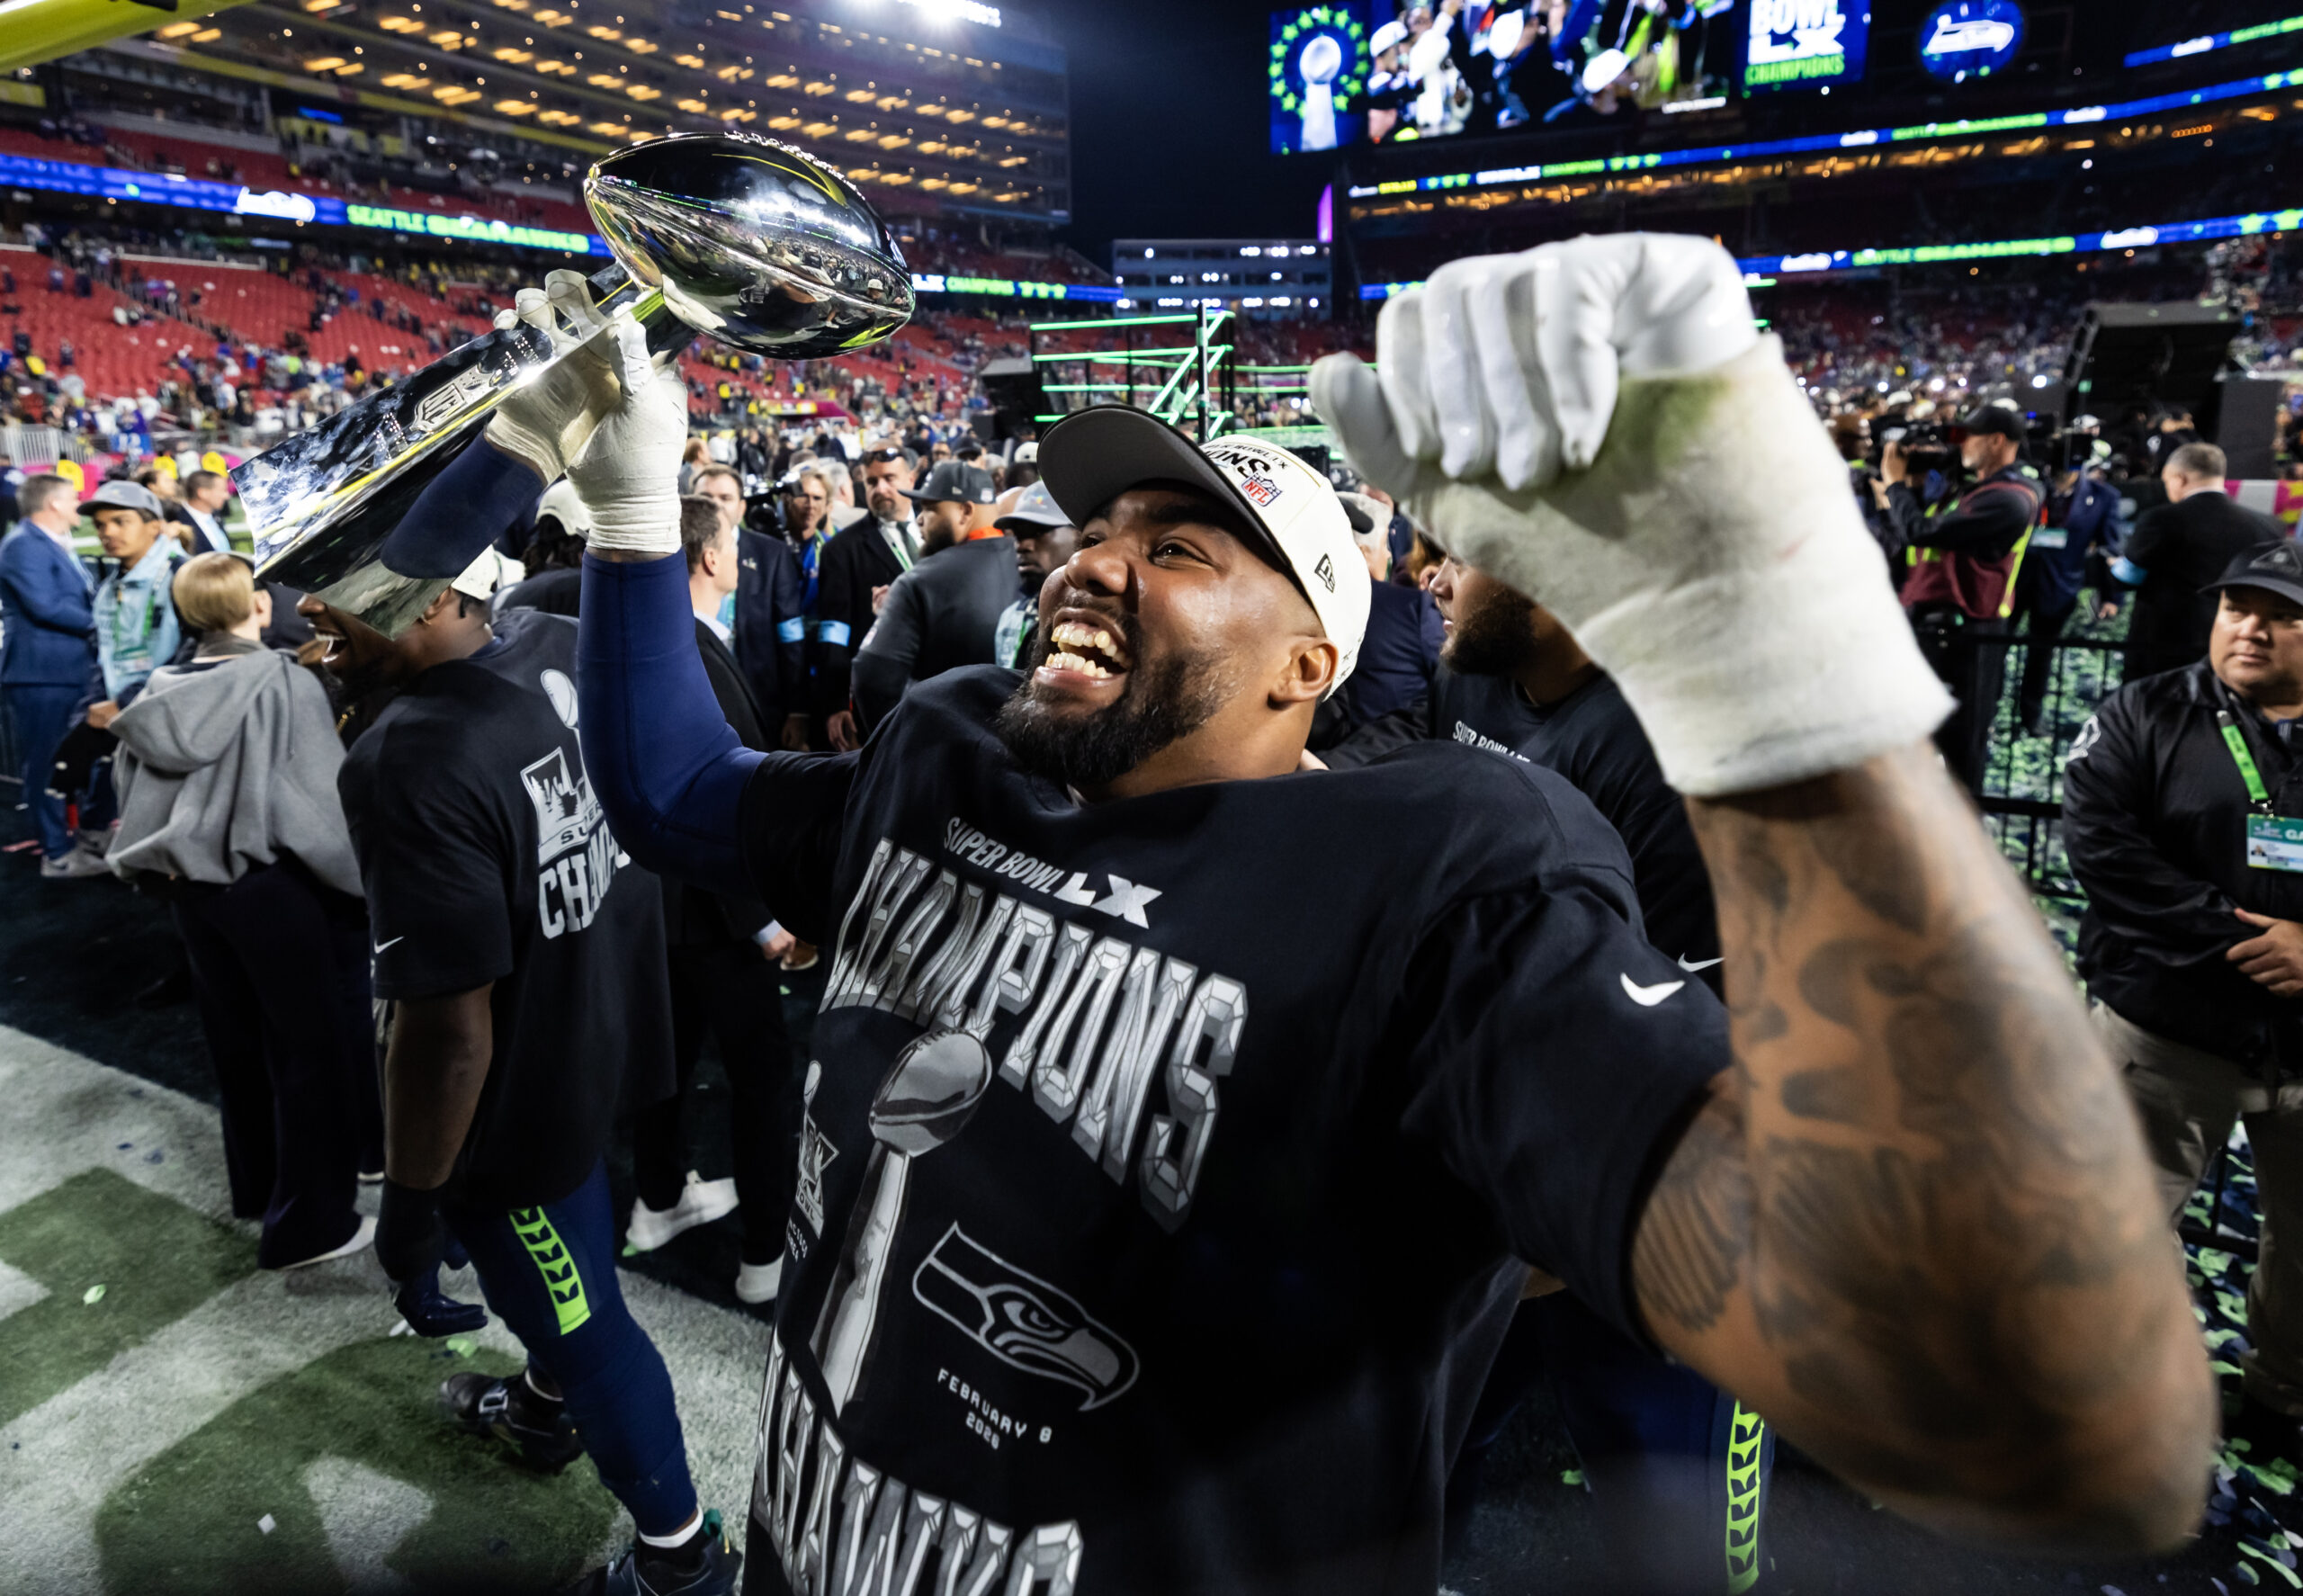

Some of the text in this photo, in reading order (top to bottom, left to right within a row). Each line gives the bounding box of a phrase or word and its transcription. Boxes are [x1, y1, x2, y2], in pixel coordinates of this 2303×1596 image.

[1748, 26, 1844, 65] LX
[1744, 53, 1845, 85] CHAMPIONS
[347, 204, 589, 253] SEATTLE SEAHAWKS
[420, 385, 462, 425] NFL
[1244, 480, 1269, 503] NFL
[944, 816, 1162, 929] SUPER BOWL LX
[818, 837, 1249, 1234] CHAMPIONS
[937, 1367, 1052, 1444] FEBRUARY 8
[965, 1412, 1000, 1449] 2026
